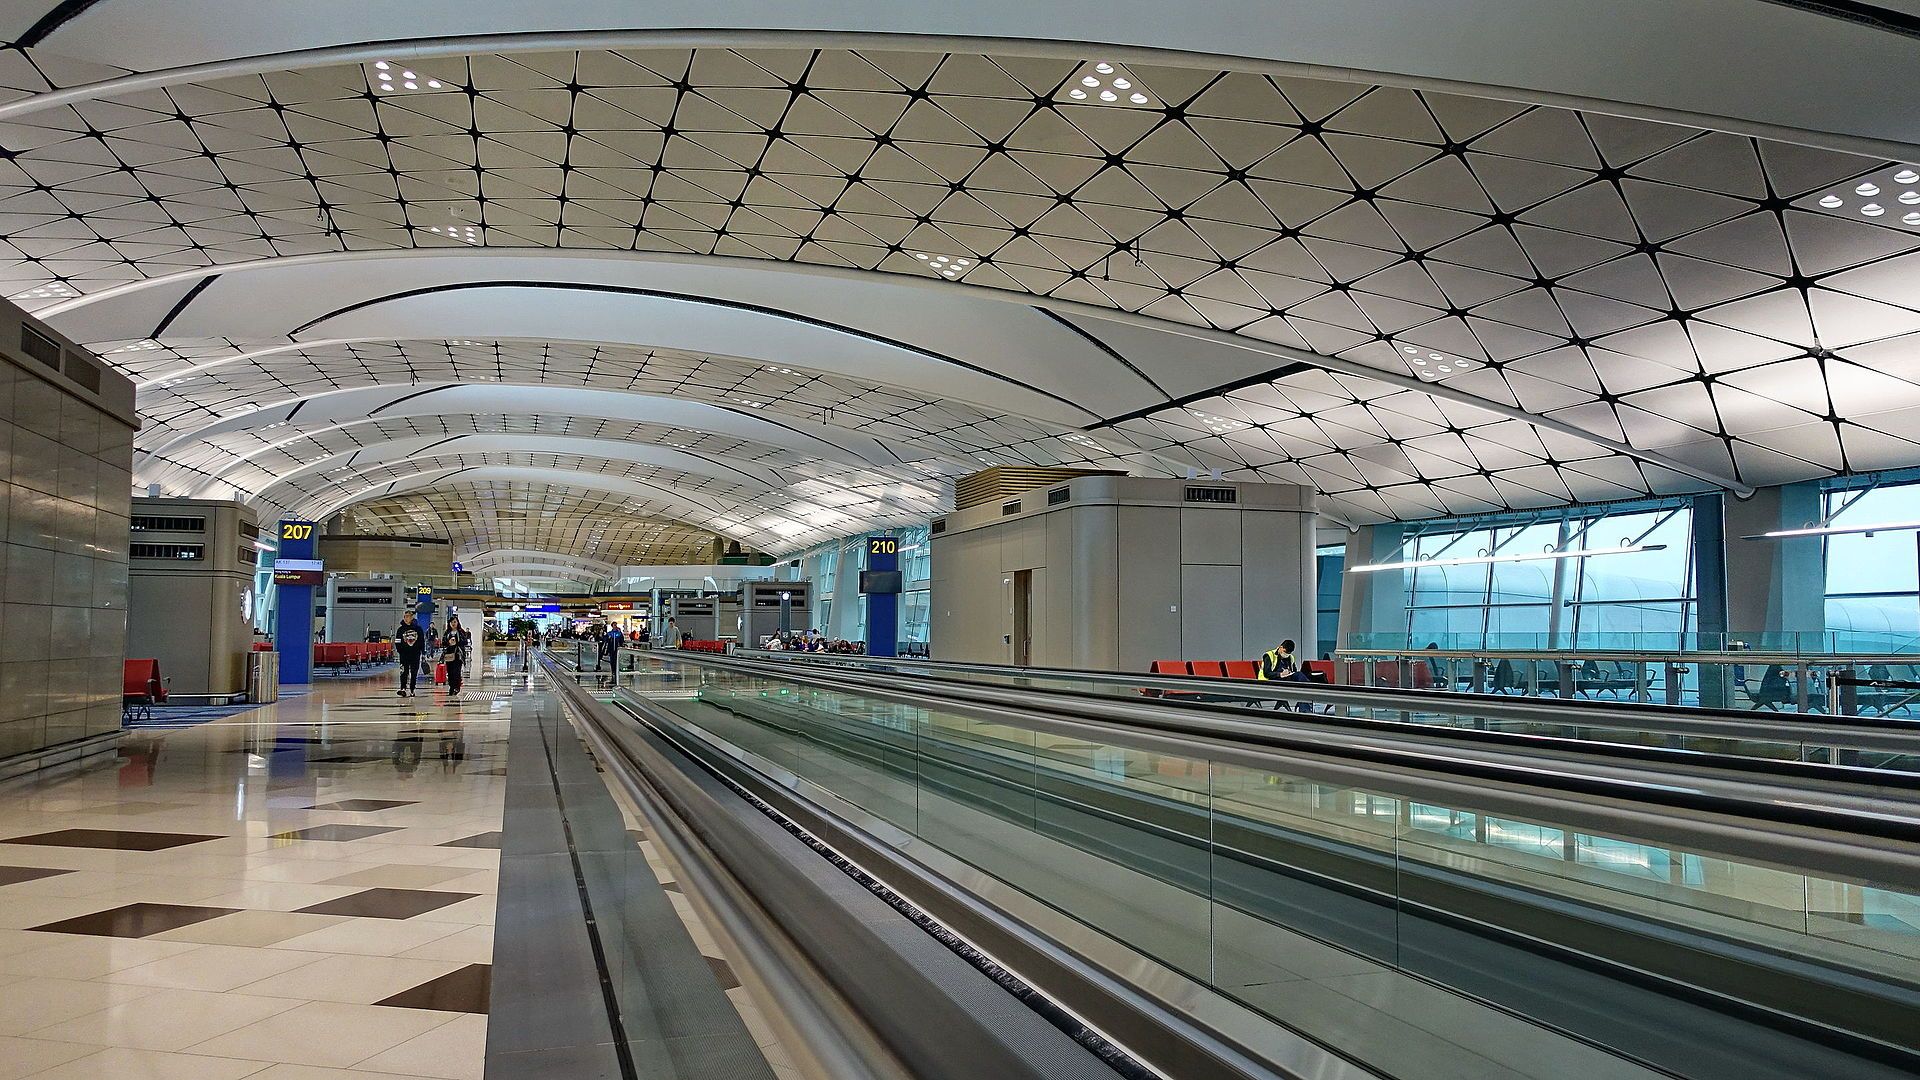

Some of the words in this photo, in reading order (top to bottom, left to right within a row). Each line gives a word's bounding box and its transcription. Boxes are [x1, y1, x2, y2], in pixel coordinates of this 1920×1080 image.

[283, 524, 313, 540] 207
[871, 540, 895, 554] 210
[418, 586, 432, 595] 209
